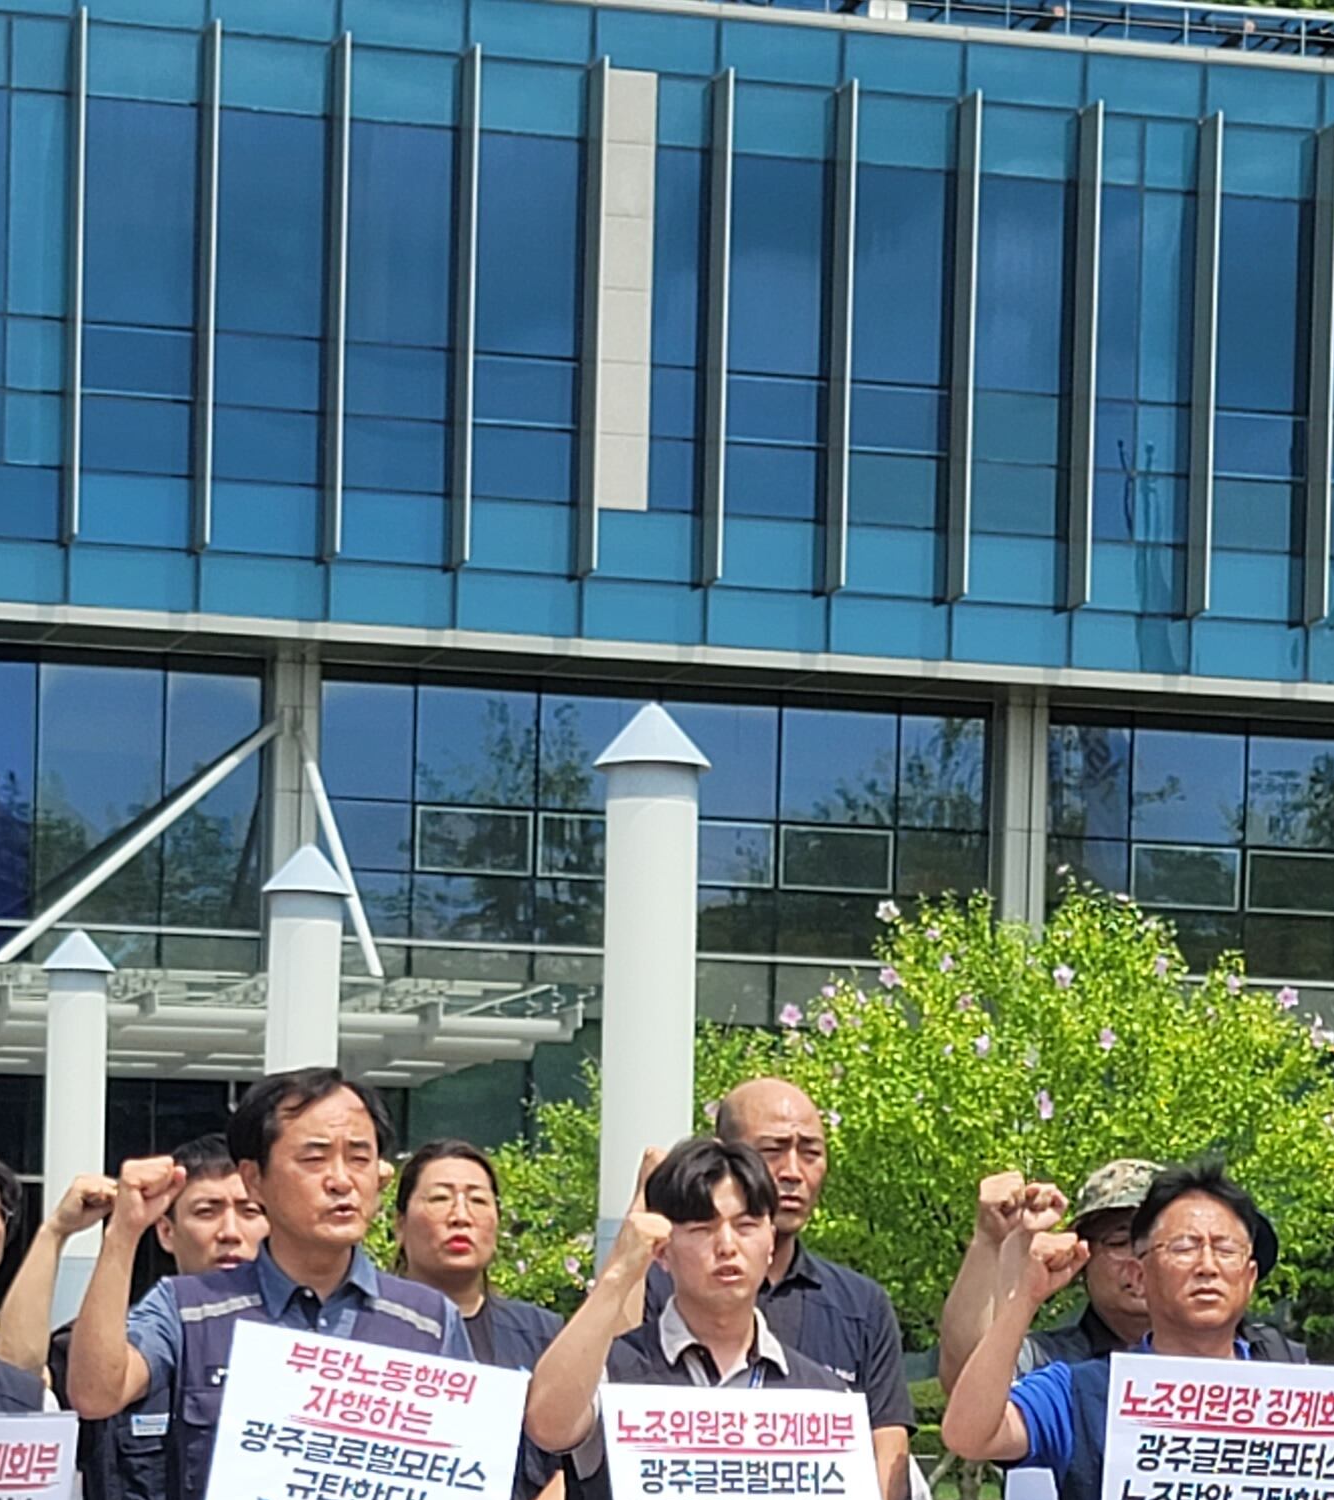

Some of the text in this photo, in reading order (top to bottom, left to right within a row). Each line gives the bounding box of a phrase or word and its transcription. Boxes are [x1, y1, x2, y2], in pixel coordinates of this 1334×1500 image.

[286, 1343, 477, 1404] 부당노동행위
[303, 1386, 434, 1435] 자행하는
[1119, 1380, 1261, 1423] 노조위원장
[617, 1410, 855, 1447] 노조위원장 징계회부
[241, 1420, 486, 1492] 광주글로벌모터스
[640, 1459, 846, 1495] 광주글로벌모터스
